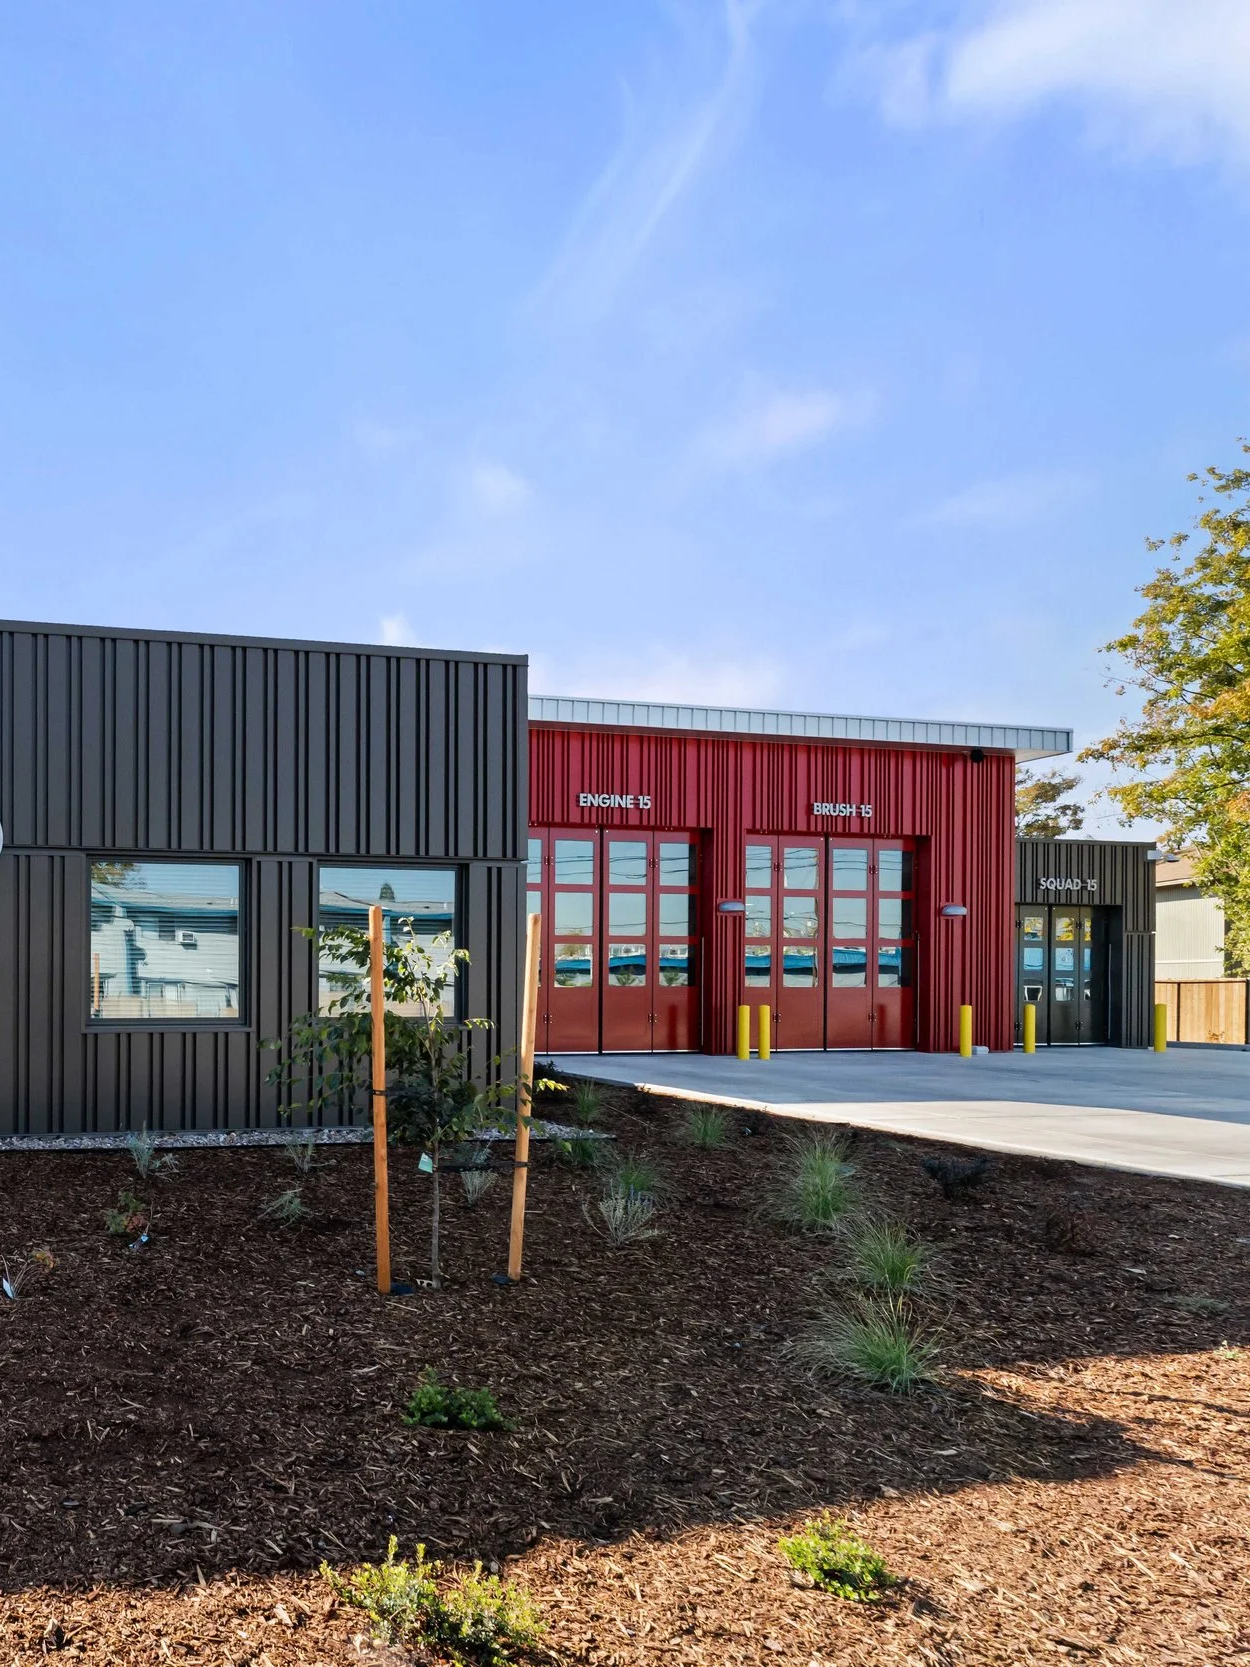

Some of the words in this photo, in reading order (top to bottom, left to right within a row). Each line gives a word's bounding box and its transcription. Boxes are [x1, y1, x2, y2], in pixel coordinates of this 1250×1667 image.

[579, 793, 634, 808] ENGINE
[637, 795, 652, 809] 15
[813, 802, 856, 816] BRUSH
[860, 804, 873, 818] 15
[1040, 878, 1081, 890] SQUAD
[1087, 879, 1098, 891] 15
